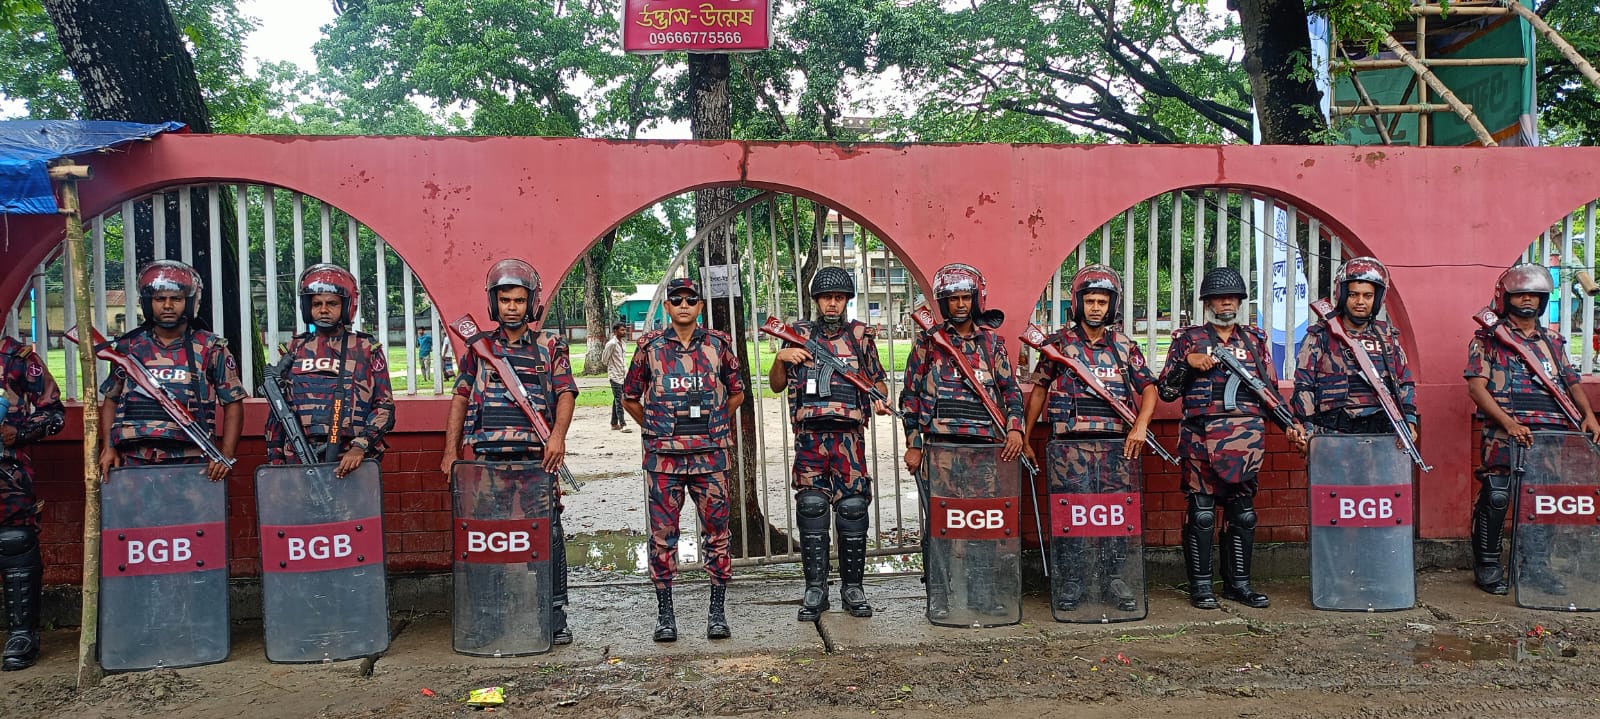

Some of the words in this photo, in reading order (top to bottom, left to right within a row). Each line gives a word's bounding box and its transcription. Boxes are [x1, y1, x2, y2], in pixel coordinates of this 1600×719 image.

[650, 31, 742, 45] 09666775566
[669, 376, 704, 391] BGB
[1071, 504, 1125, 527] BGB
[1339, 498, 1393, 520] BGB
[1535, 495, 1595, 515] BGB
[946, 508, 1004, 530] BGB
[128, 537, 192, 564] BGB
[288, 534, 353, 562] BGB
[468, 531, 531, 553] BGB
